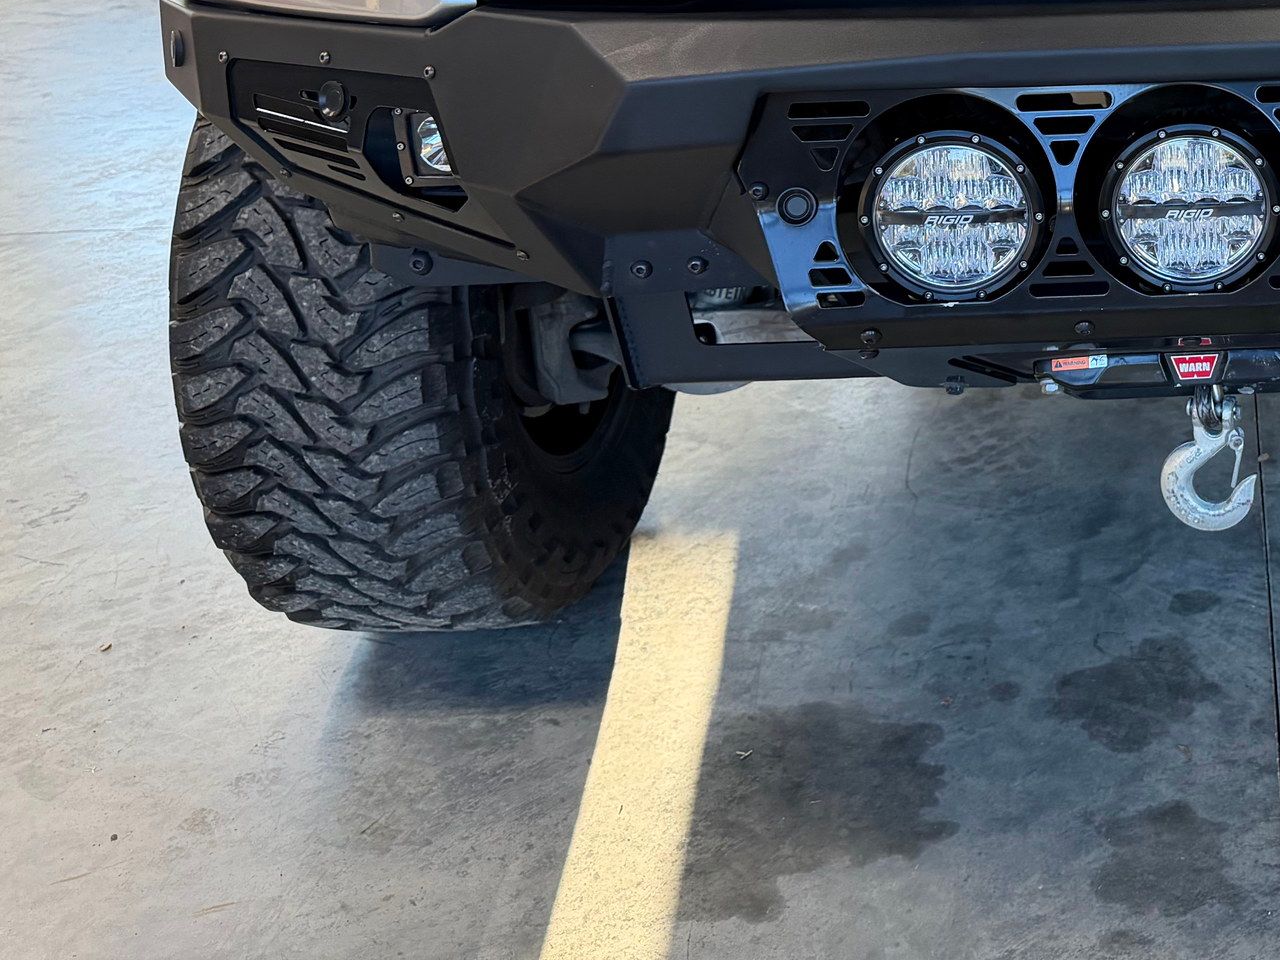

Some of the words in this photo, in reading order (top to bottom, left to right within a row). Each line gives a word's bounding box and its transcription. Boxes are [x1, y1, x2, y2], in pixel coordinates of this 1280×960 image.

[1165, 208, 1214, 219] RIGID
[924, 214, 974, 225] RIGID
[1178, 361, 1211, 373] WARN
